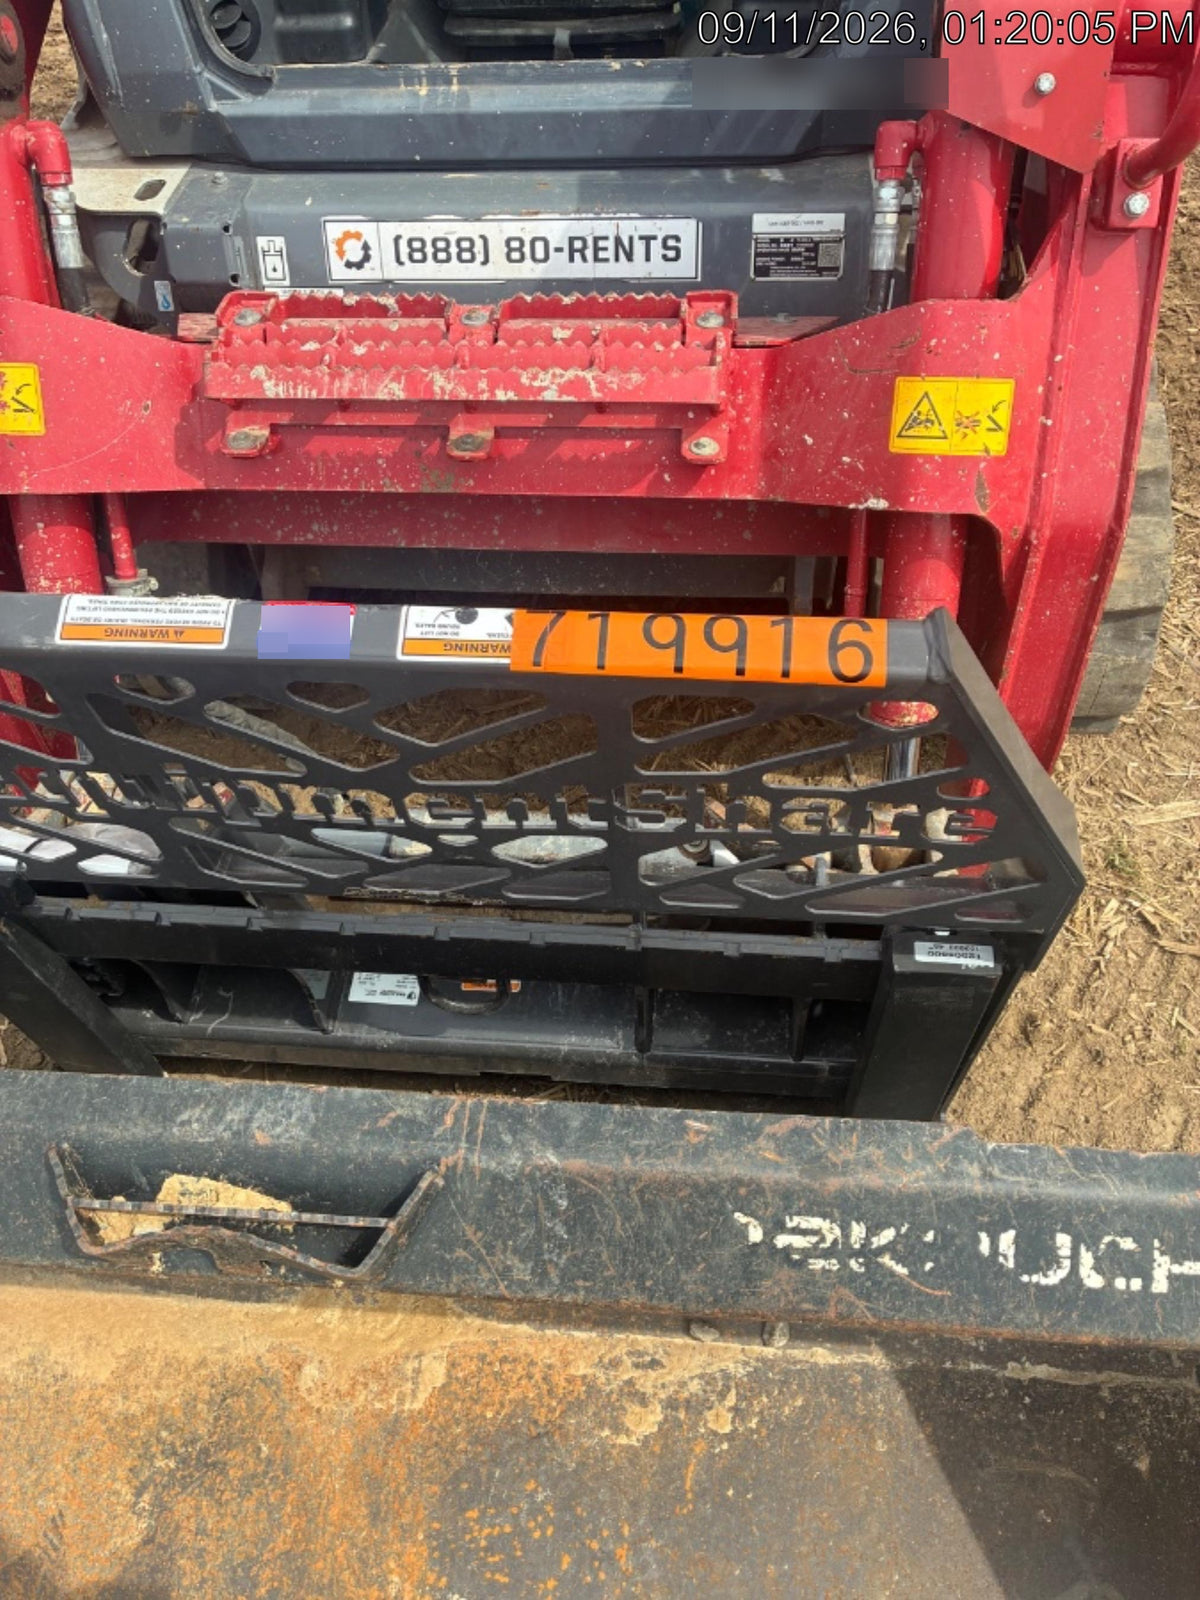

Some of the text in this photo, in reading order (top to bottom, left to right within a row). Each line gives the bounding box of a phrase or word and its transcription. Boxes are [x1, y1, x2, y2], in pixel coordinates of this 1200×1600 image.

[393, 233, 683, 267] (888) 80-RENTS
[103, 627, 170, 639] WARNING
[443, 643, 511, 653] WARNING
[525, 609, 875, 684] 719916
[0, 764, 999, 847] quipmentShare
